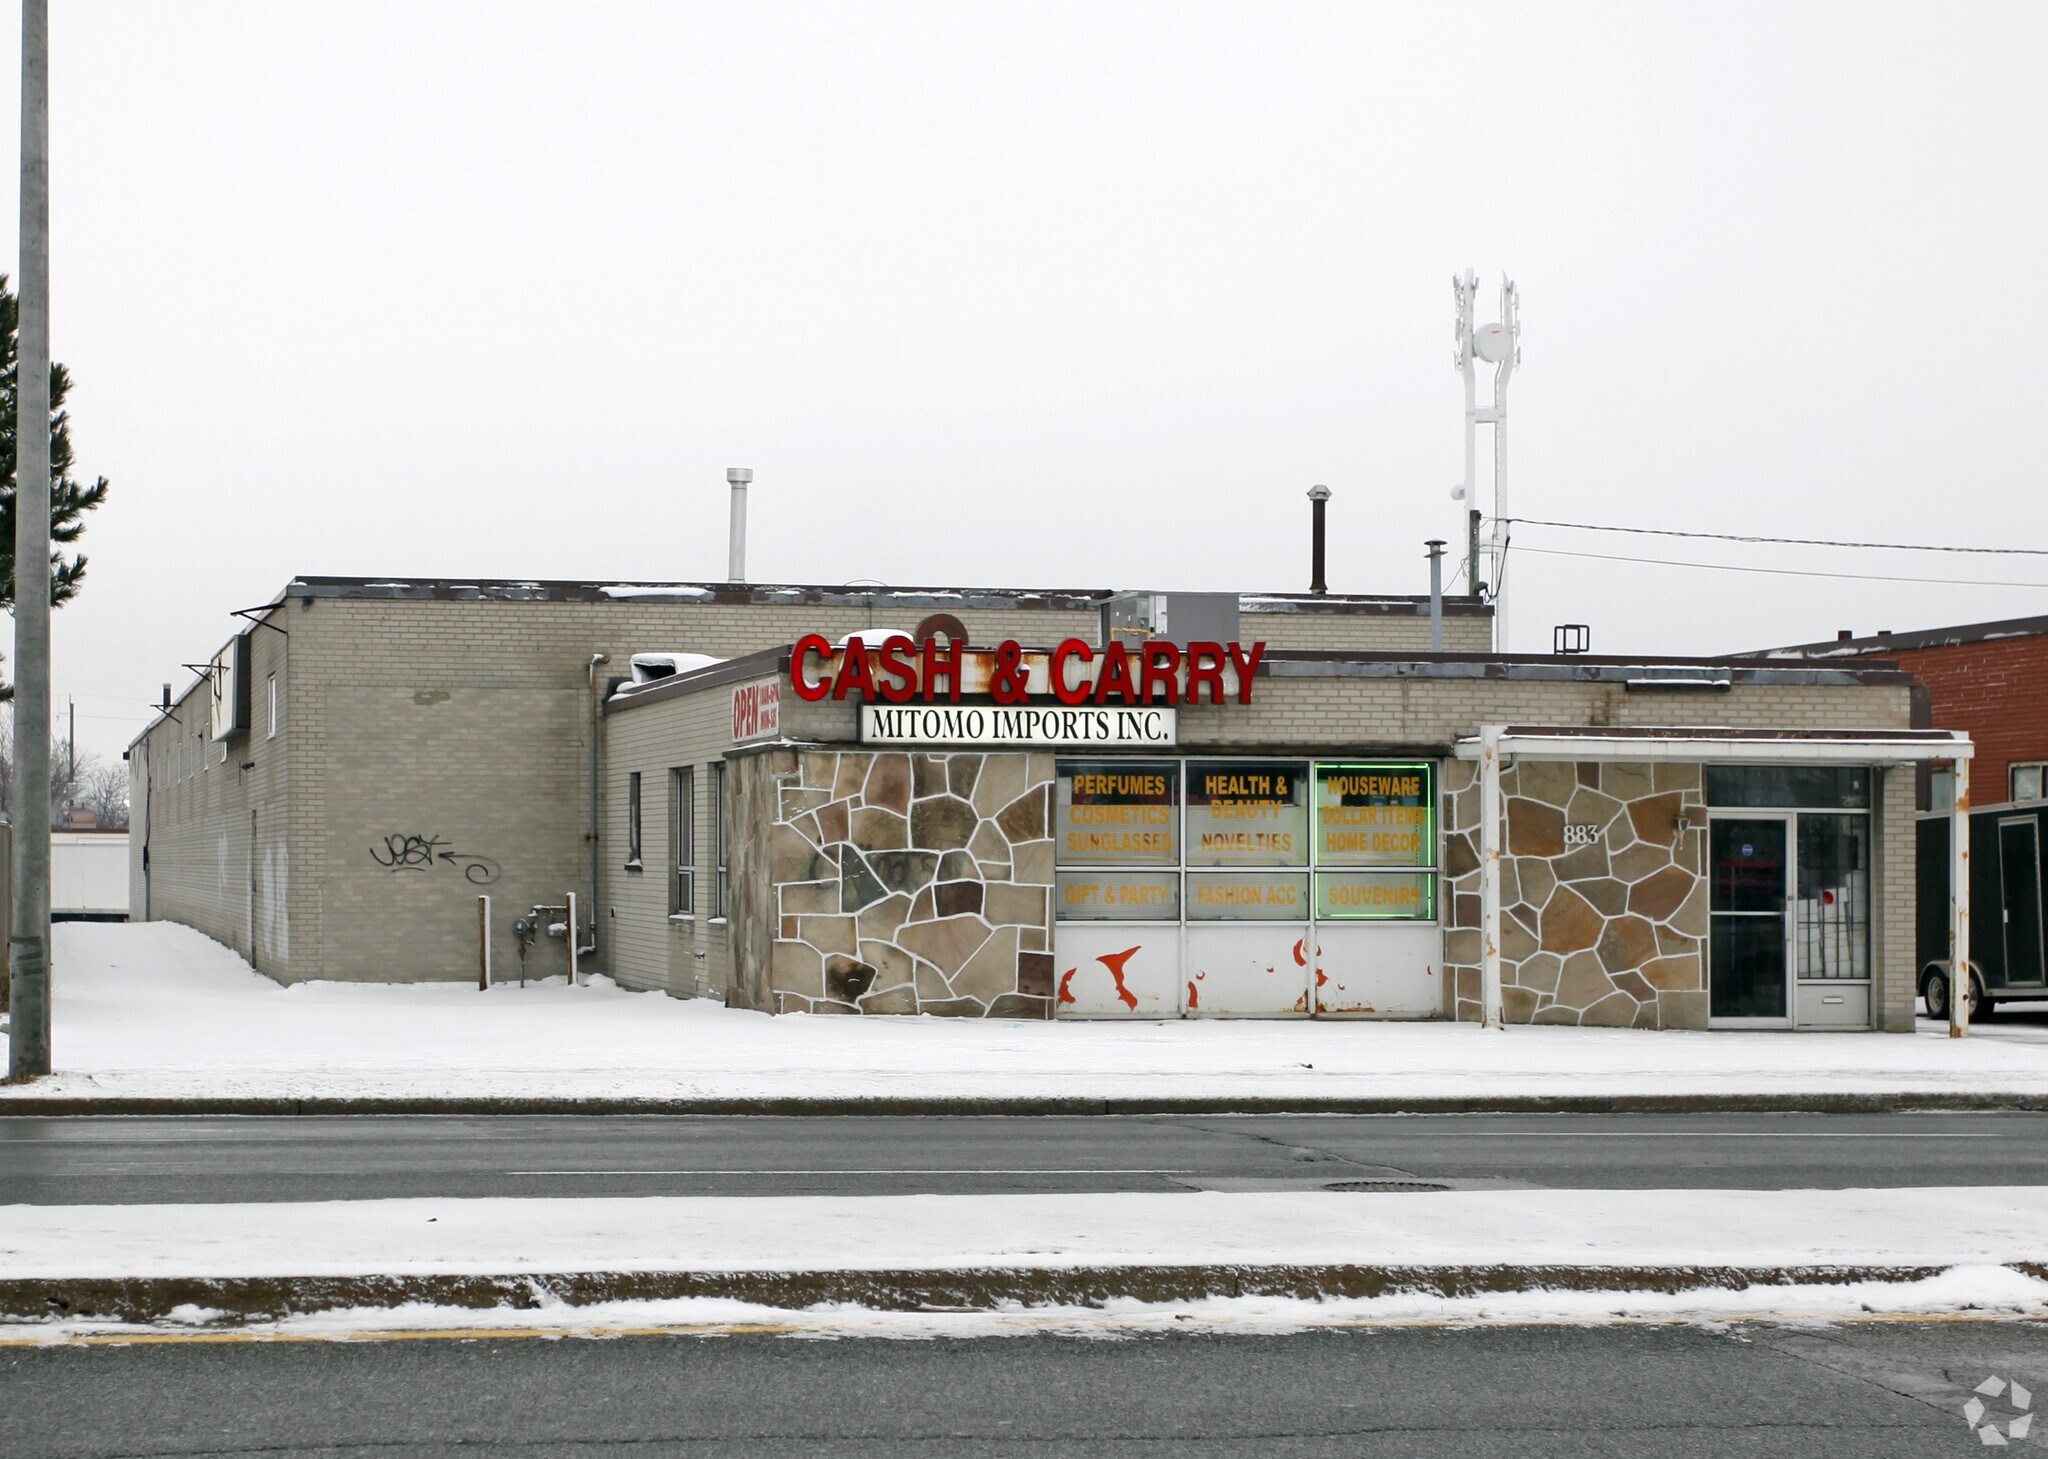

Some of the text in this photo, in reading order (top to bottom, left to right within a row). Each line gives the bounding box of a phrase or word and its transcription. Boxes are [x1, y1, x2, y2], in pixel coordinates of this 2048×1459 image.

[790, 634, 1266, 705] CASH & CARRY
[733, 685, 759, 739] OPEN
[872, 709, 1169, 741] MITOMO IMPORTS INC.
[1074, 775, 1165, 796] PERFUMES
[1205, 775, 1288, 795] HEALTH &
[1327, 776, 1420, 796] HOUSEWARE
[1071, 805, 1169, 825] COSMETICS
[1211, 800, 1283, 819] BEAUTY
[1322, 806, 1425, 825] DOLLAR ITEMS
[1067, 832, 1172, 853] SUNGLASSES
[1201, 832, 1292, 852] NOVELTIES
[1326, 832, 1420, 852] HOME DECOR
[1563, 825, 1599, 844] 883
[1065, 884, 1169, 905] GIFT & PARTY
[1197, 885, 1297, 905] FASHION ACC
[1329, 886, 1420, 906] SOUVENIRS
